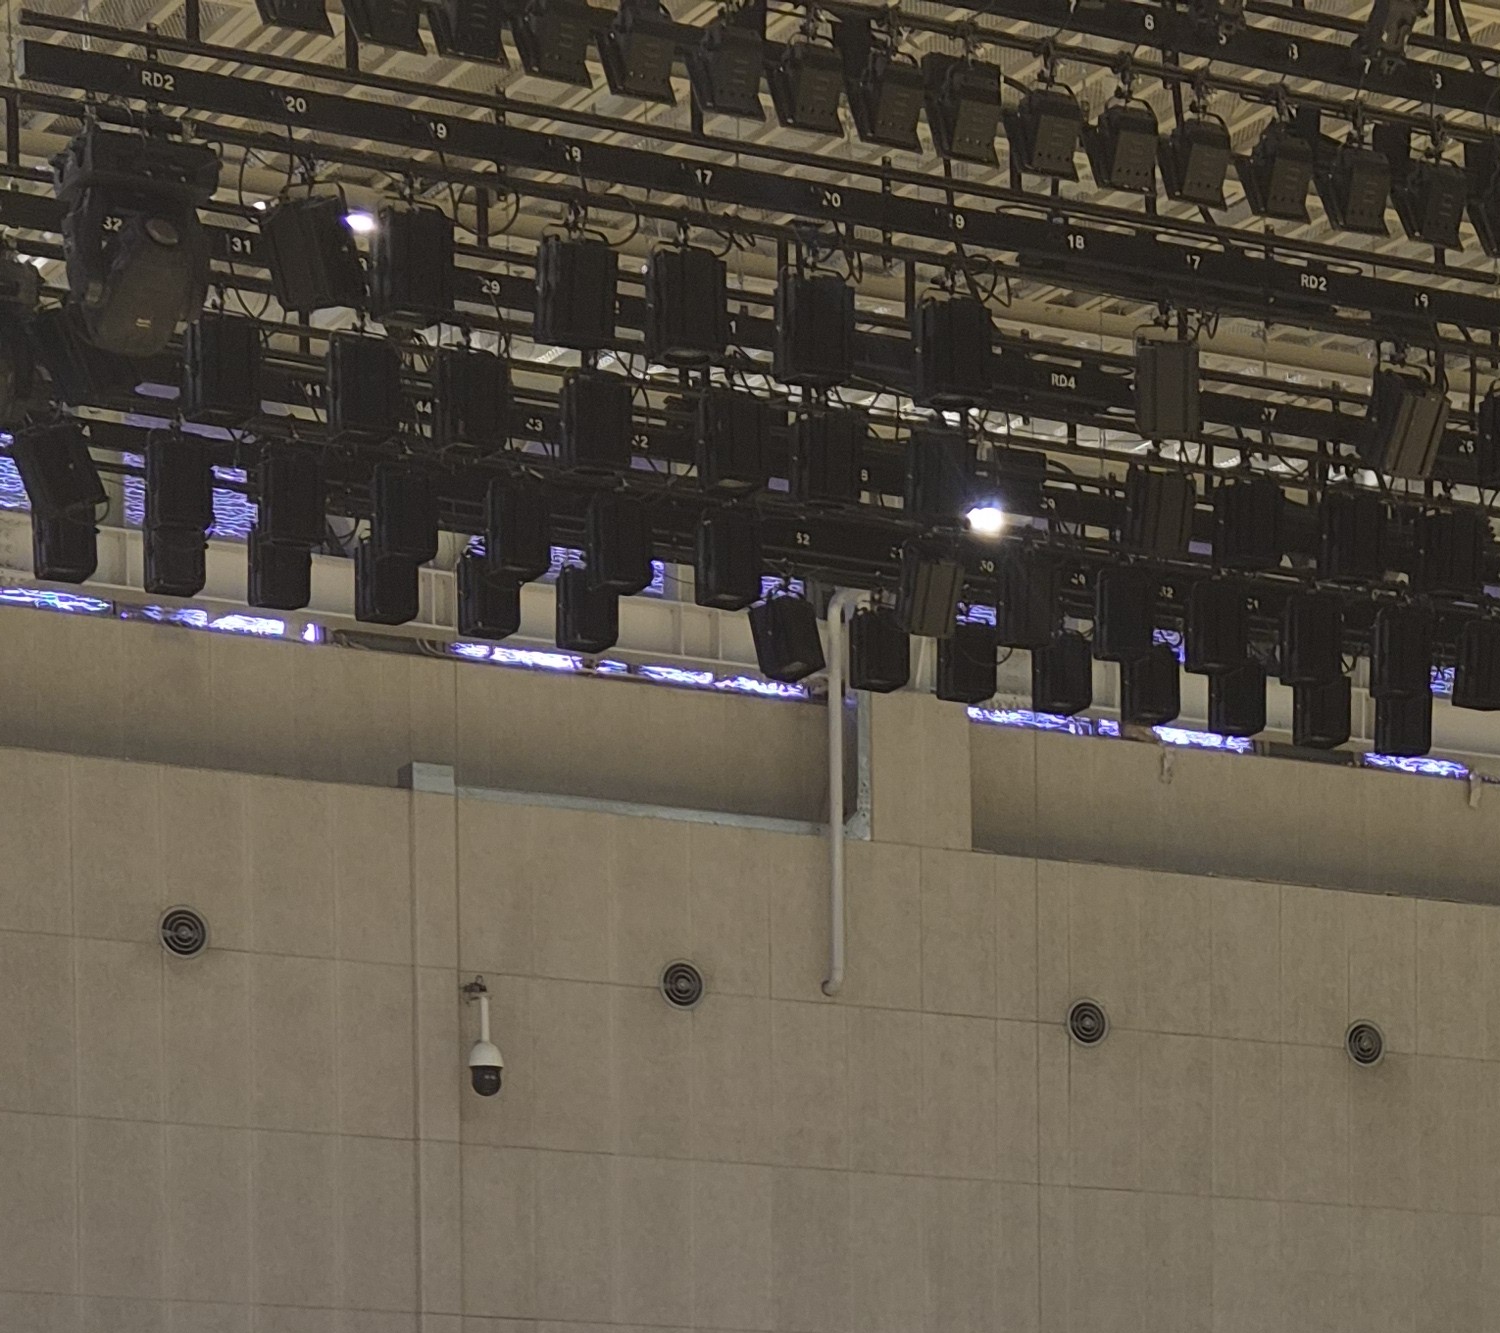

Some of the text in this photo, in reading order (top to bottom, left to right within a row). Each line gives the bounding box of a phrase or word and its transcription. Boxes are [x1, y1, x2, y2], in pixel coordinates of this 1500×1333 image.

[141, 70, 175, 91] RD2
[285, 96, 307, 113] 20
[695, 169, 713, 185] 17
[232, 237, 252, 255] 31
[1301, 273, 1327, 291] RD2
[1051, 373, 1076, 390] RD4
